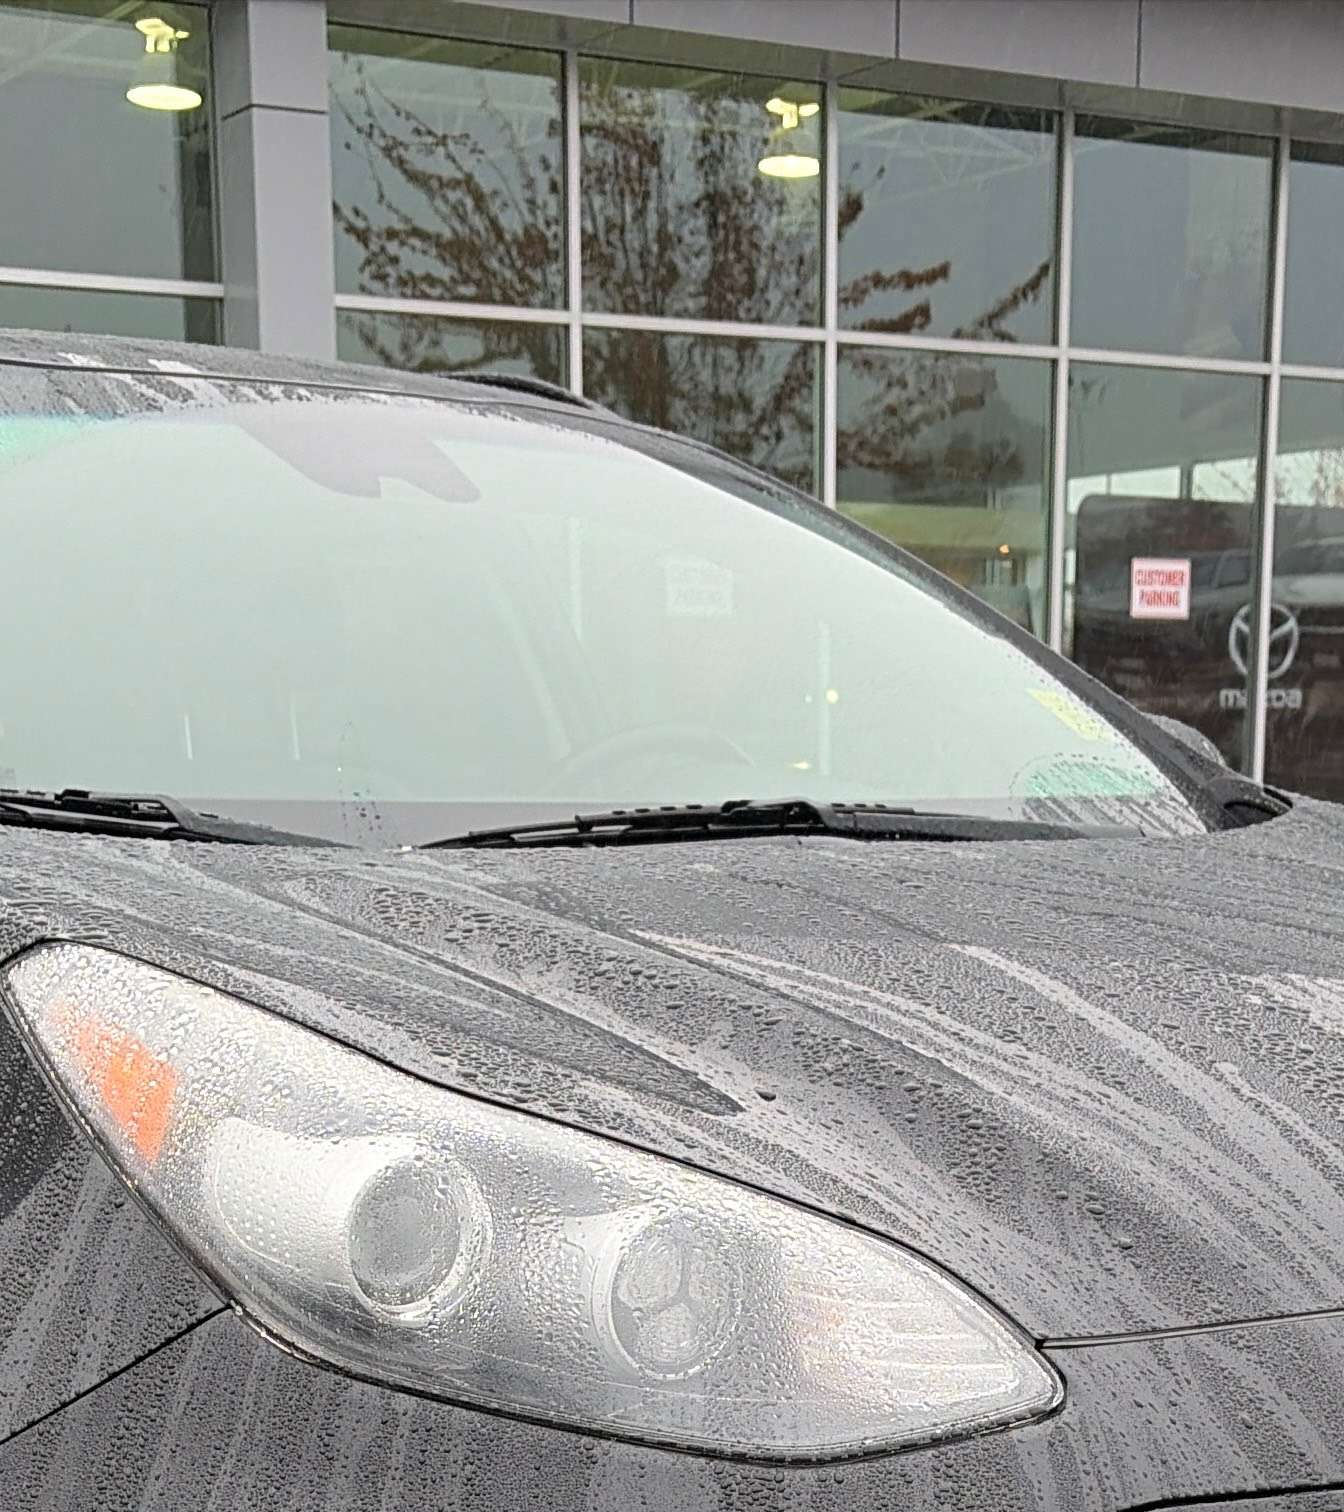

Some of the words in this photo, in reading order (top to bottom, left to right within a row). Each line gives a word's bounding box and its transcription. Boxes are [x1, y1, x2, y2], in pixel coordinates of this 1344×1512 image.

[1135, 569, 1185, 586] CUSTOMER
[1139, 590, 1180, 607] PARKING
[1219, 688, 1303, 709] mada
